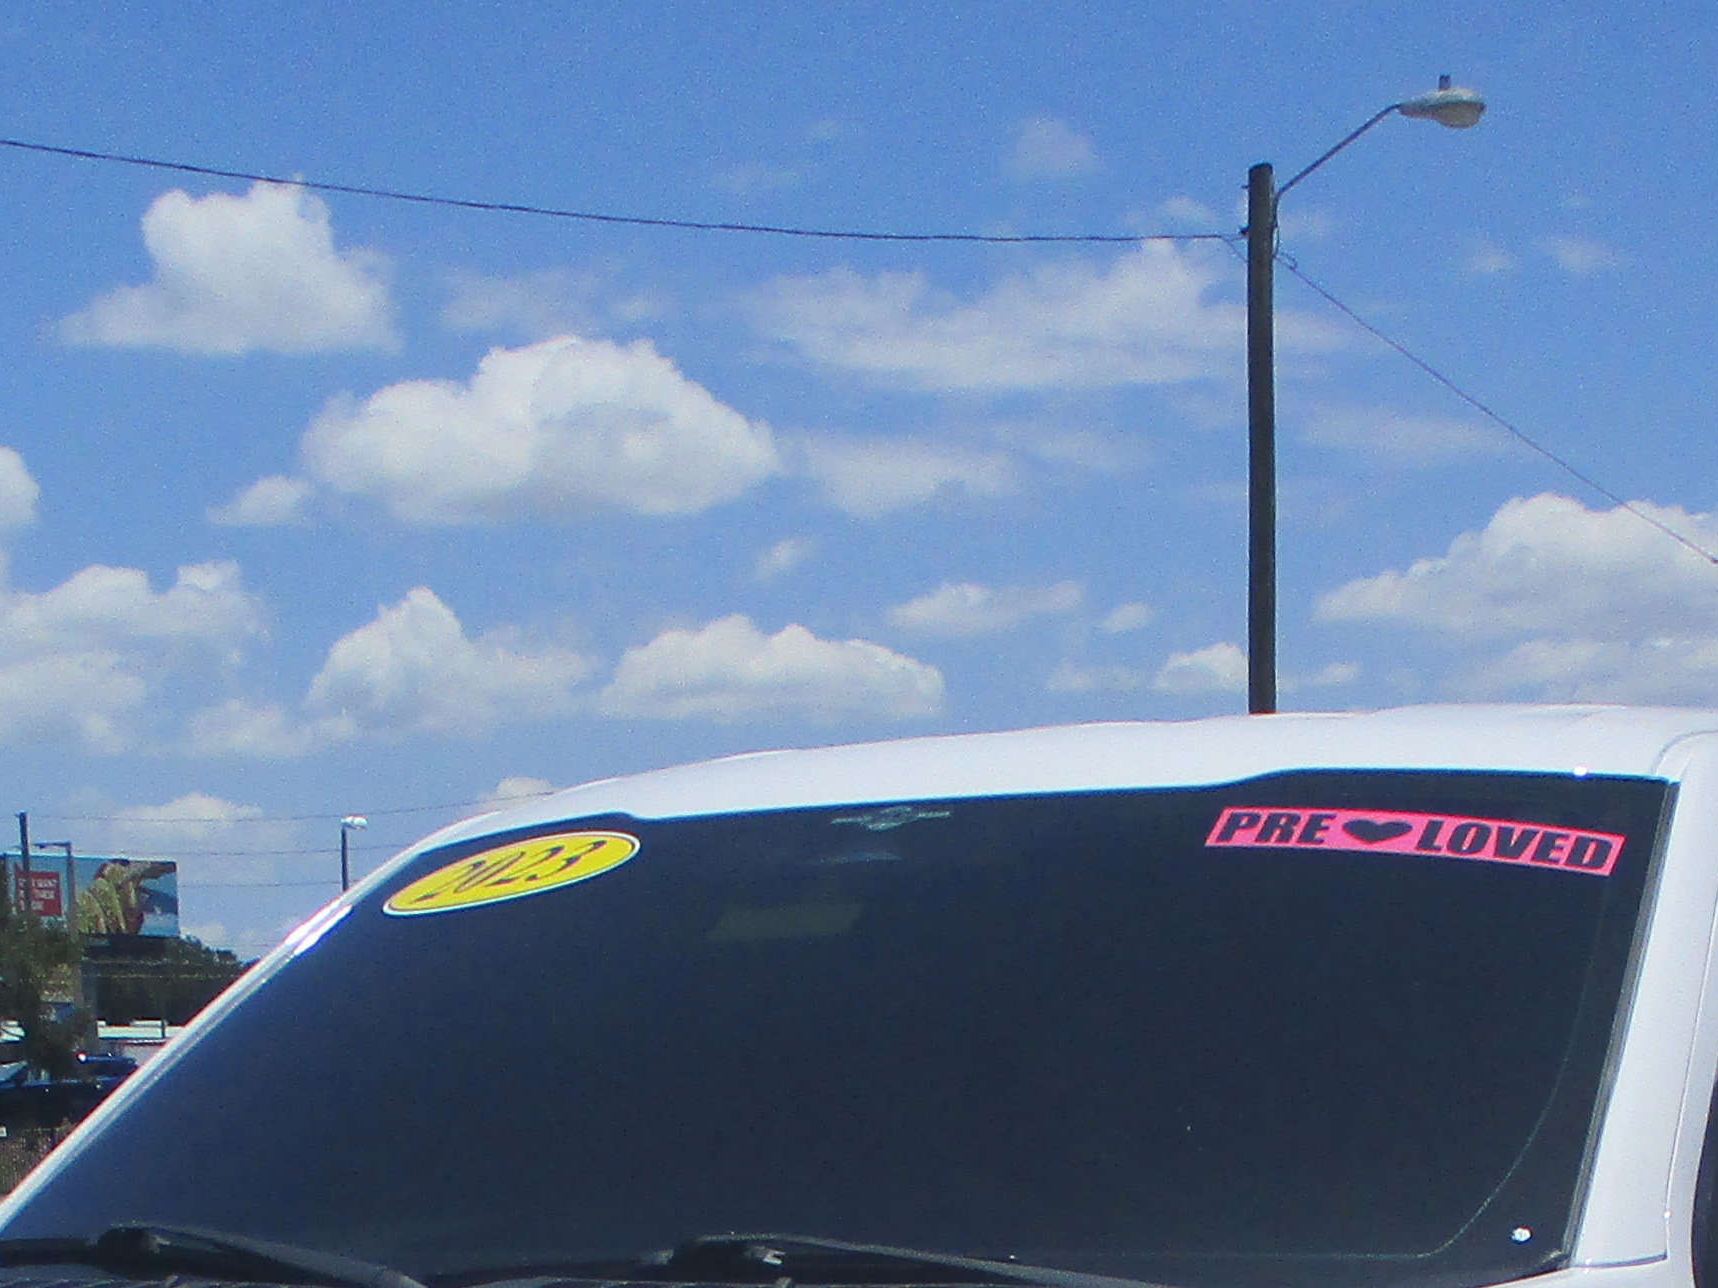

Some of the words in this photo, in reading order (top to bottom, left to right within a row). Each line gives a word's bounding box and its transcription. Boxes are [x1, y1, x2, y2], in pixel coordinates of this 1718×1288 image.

[1217, 810, 1337, 845] PRE
[1414, 819, 1613, 870] LOVED
[407, 839, 609, 905] 2023
